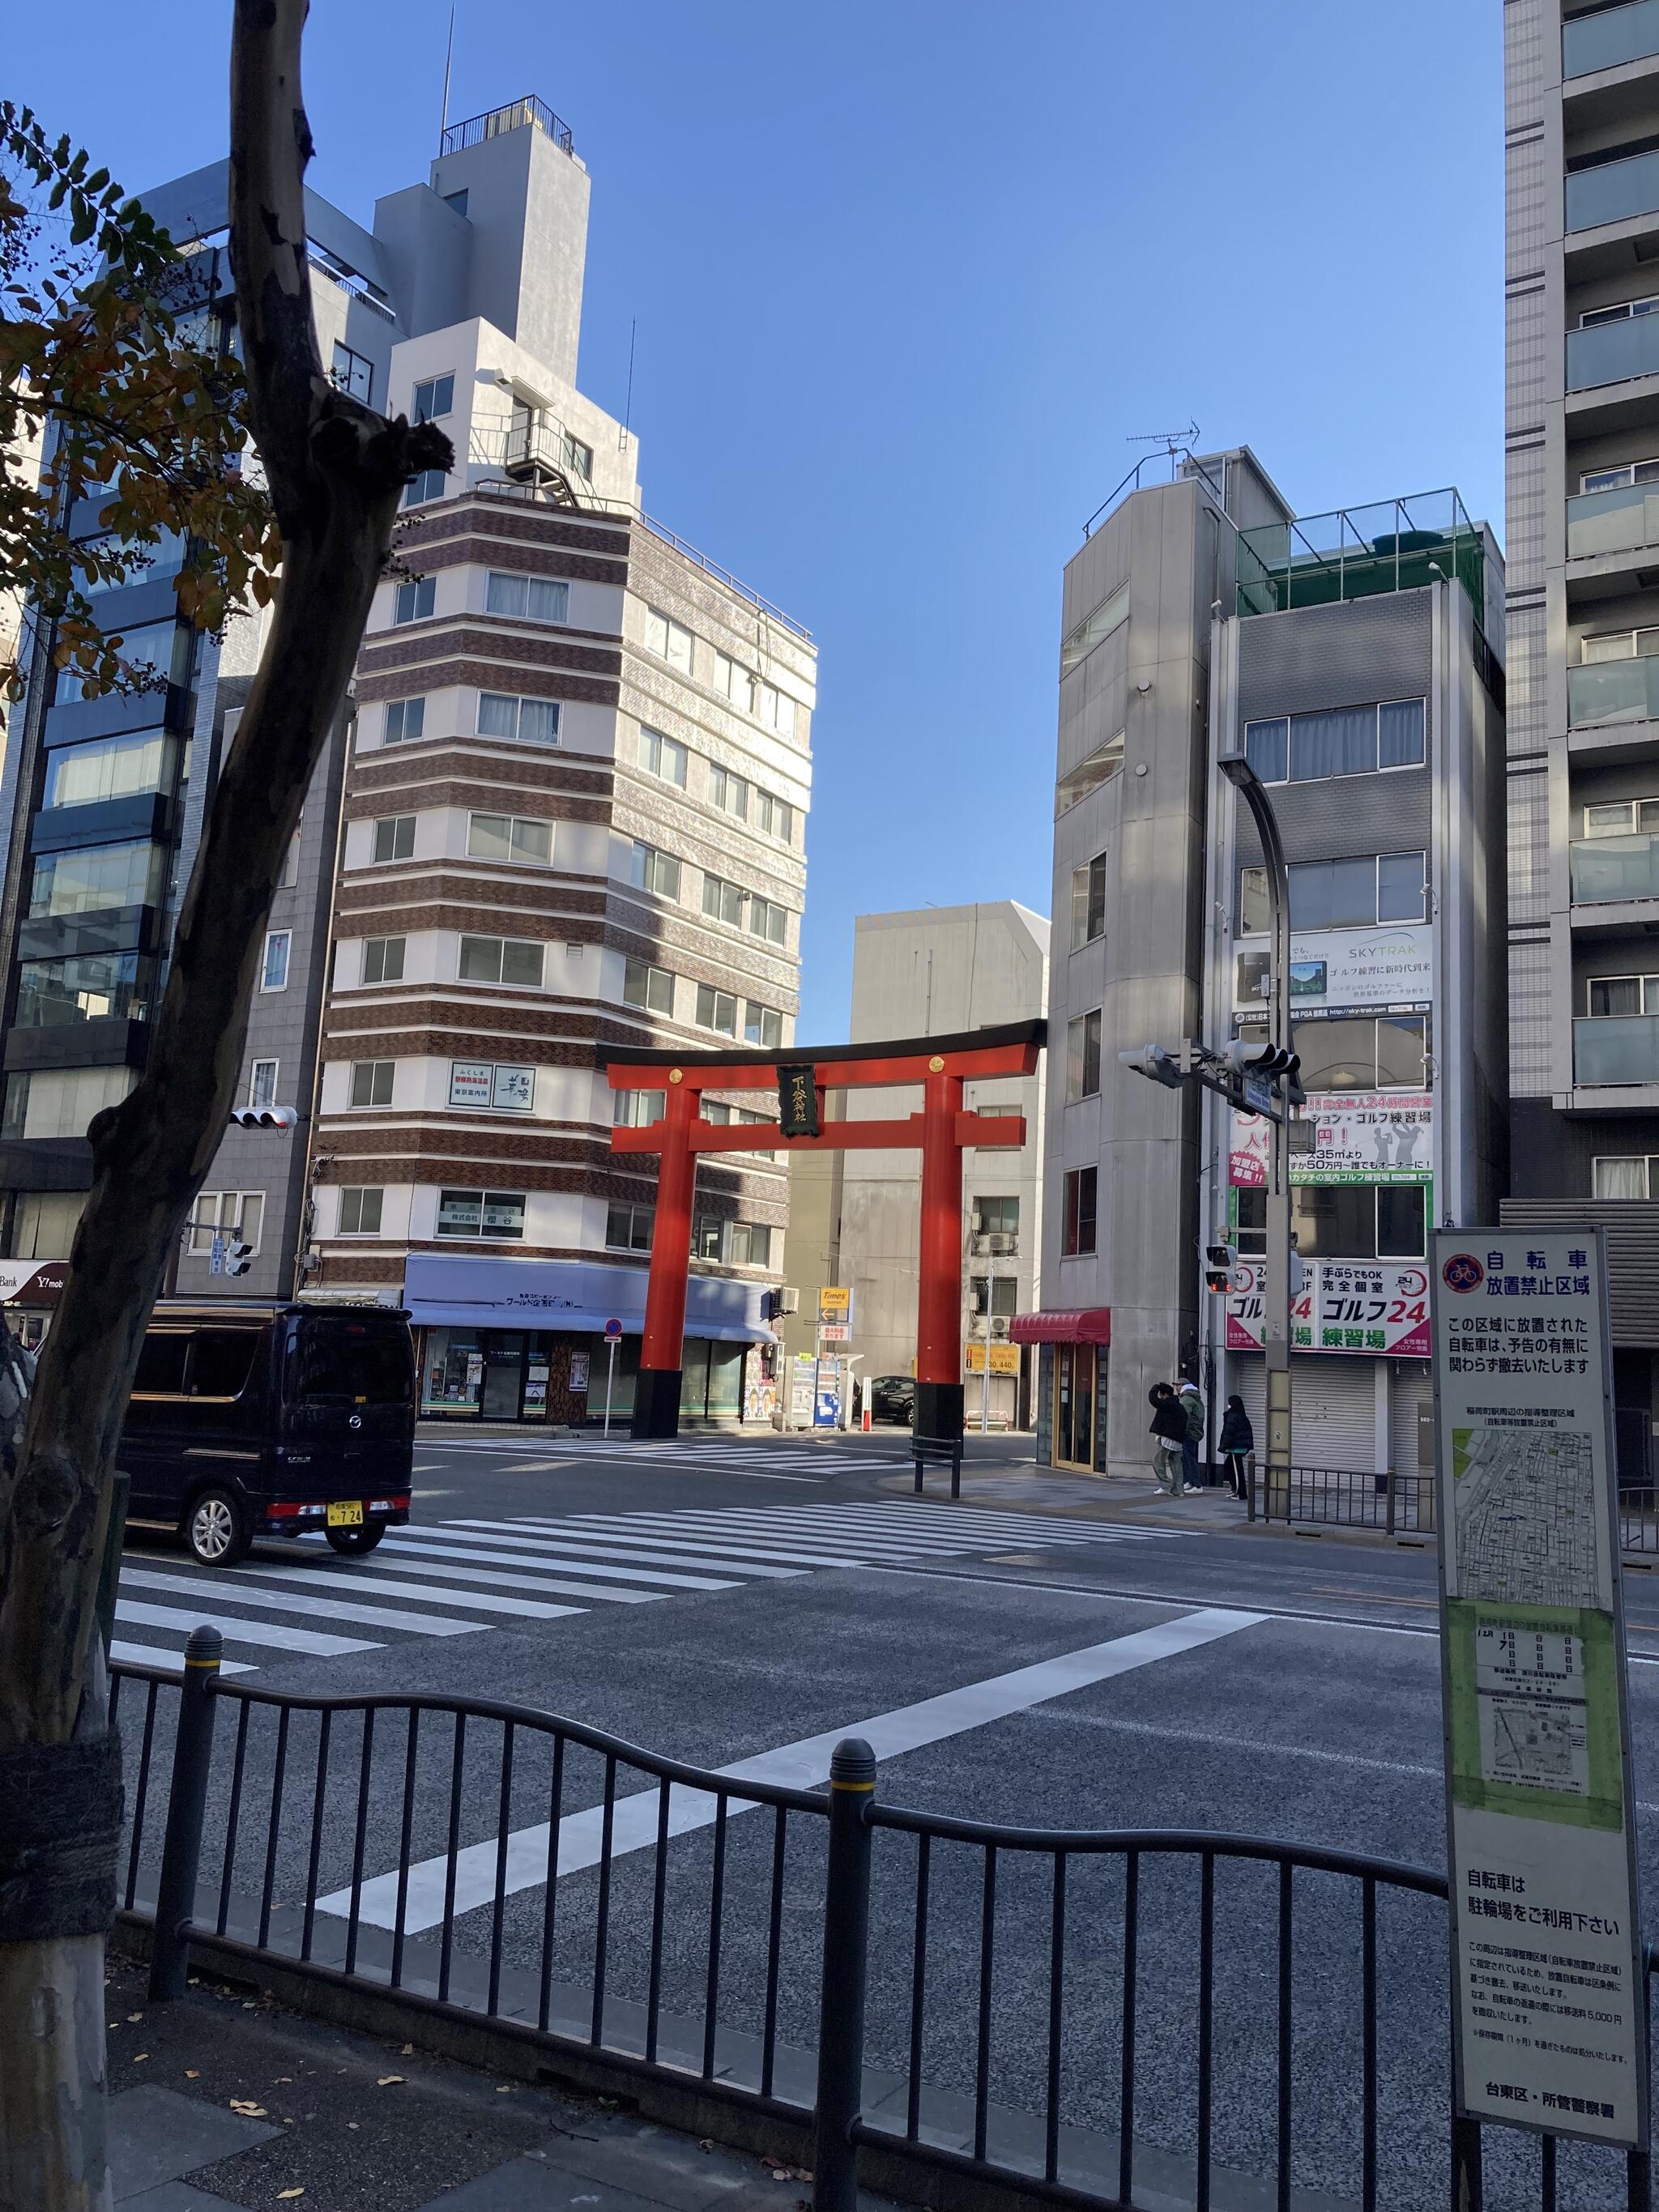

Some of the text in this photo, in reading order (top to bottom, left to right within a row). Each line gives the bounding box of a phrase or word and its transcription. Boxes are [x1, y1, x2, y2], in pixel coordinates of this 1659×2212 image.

[1350, 945, 1416, 959] SKYTRAK
[1300, 1010, 1312, 1018] PGA
[1329, 1007, 1387, 1016] http://sky-trak.com
[455, 1089, 488, 1098] 東京案内所
[791, 1076, 807, 1123] 下谷神社
[1230, 1154, 1260, 1172] 加盟店
[452, 1214, 478, 1222] 株式会社
[1487, 1250, 1589, 1270] 自転車
[1322, 1267, 1383, 1280] 手ぶらでもOK
[1322, 1280, 1383, 1294] 完全個室
[1486, 1276, 1590, 1296] 放置禁止区域
[824, 1291, 847, 1300] Times
[1322, 1298, 1427, 1324] ゴルフ24
[1448, 1317, 1589, 1333] この区域に放置された
[1322, 1327, 1386, 1349] 練習場
[1448, 1336, 1589, 1353] 自転車は、予告の有無に
[1448, 1357, 1589, 1375] 関わらず撤去いたします
[1468, 1869, 1525, 1893] 自転車は
[1468, 1895, 1620, 1936] 駐輪場をご利用下さい
[1486, 2081, 1614, 2120] 台東区・所管警察署
